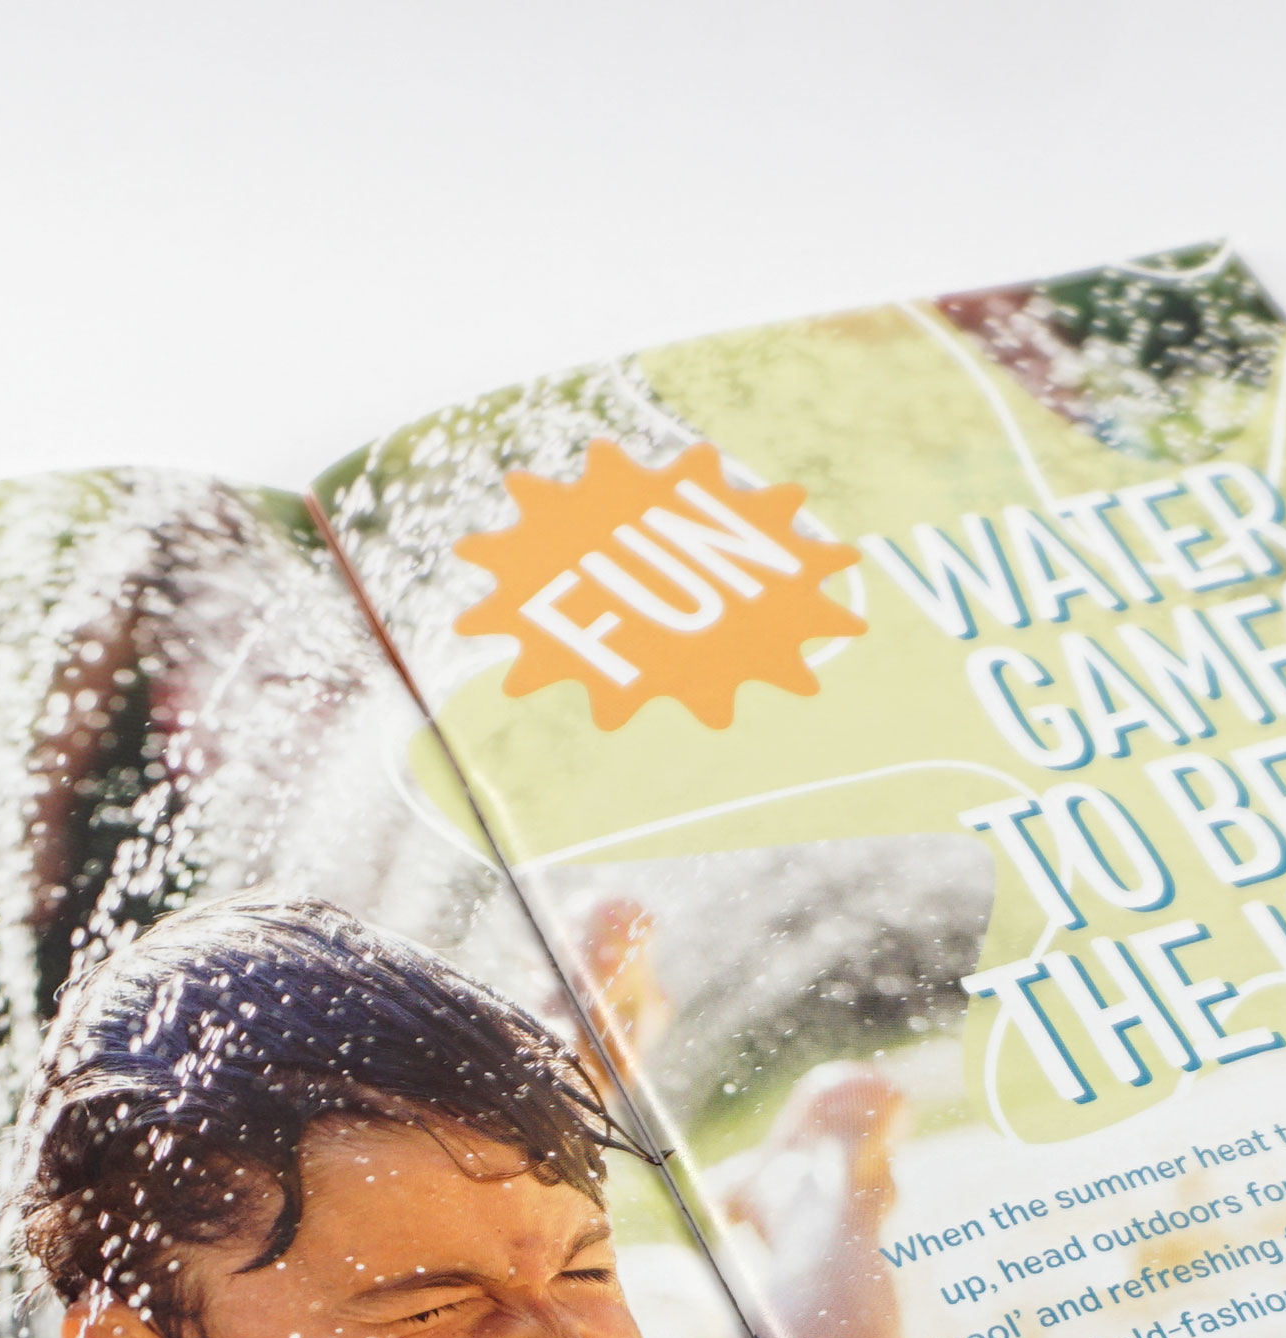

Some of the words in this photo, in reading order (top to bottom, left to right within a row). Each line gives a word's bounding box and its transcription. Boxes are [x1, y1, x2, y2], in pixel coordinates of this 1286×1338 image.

[518, 479, 802, 686] FUN
[958, 783, 1176, 930] TO
[959, 919, 1286, 1104] THE
[881, 1220, 986, 1267] When
[990, 1201, 1048, 1230] the
[1055, 1156, 1185, 1208] summer
[1193, 1132, 1269, 1167] heat
[941, 1275, 998, 1305] up,
[998, 1236, 1087, 1283] head
[1093, 1197, 1242, 1251] outdoors
[1038, 1287, 1103, 1327] and
[1108, 1240, 1284, 1303] refreshing
